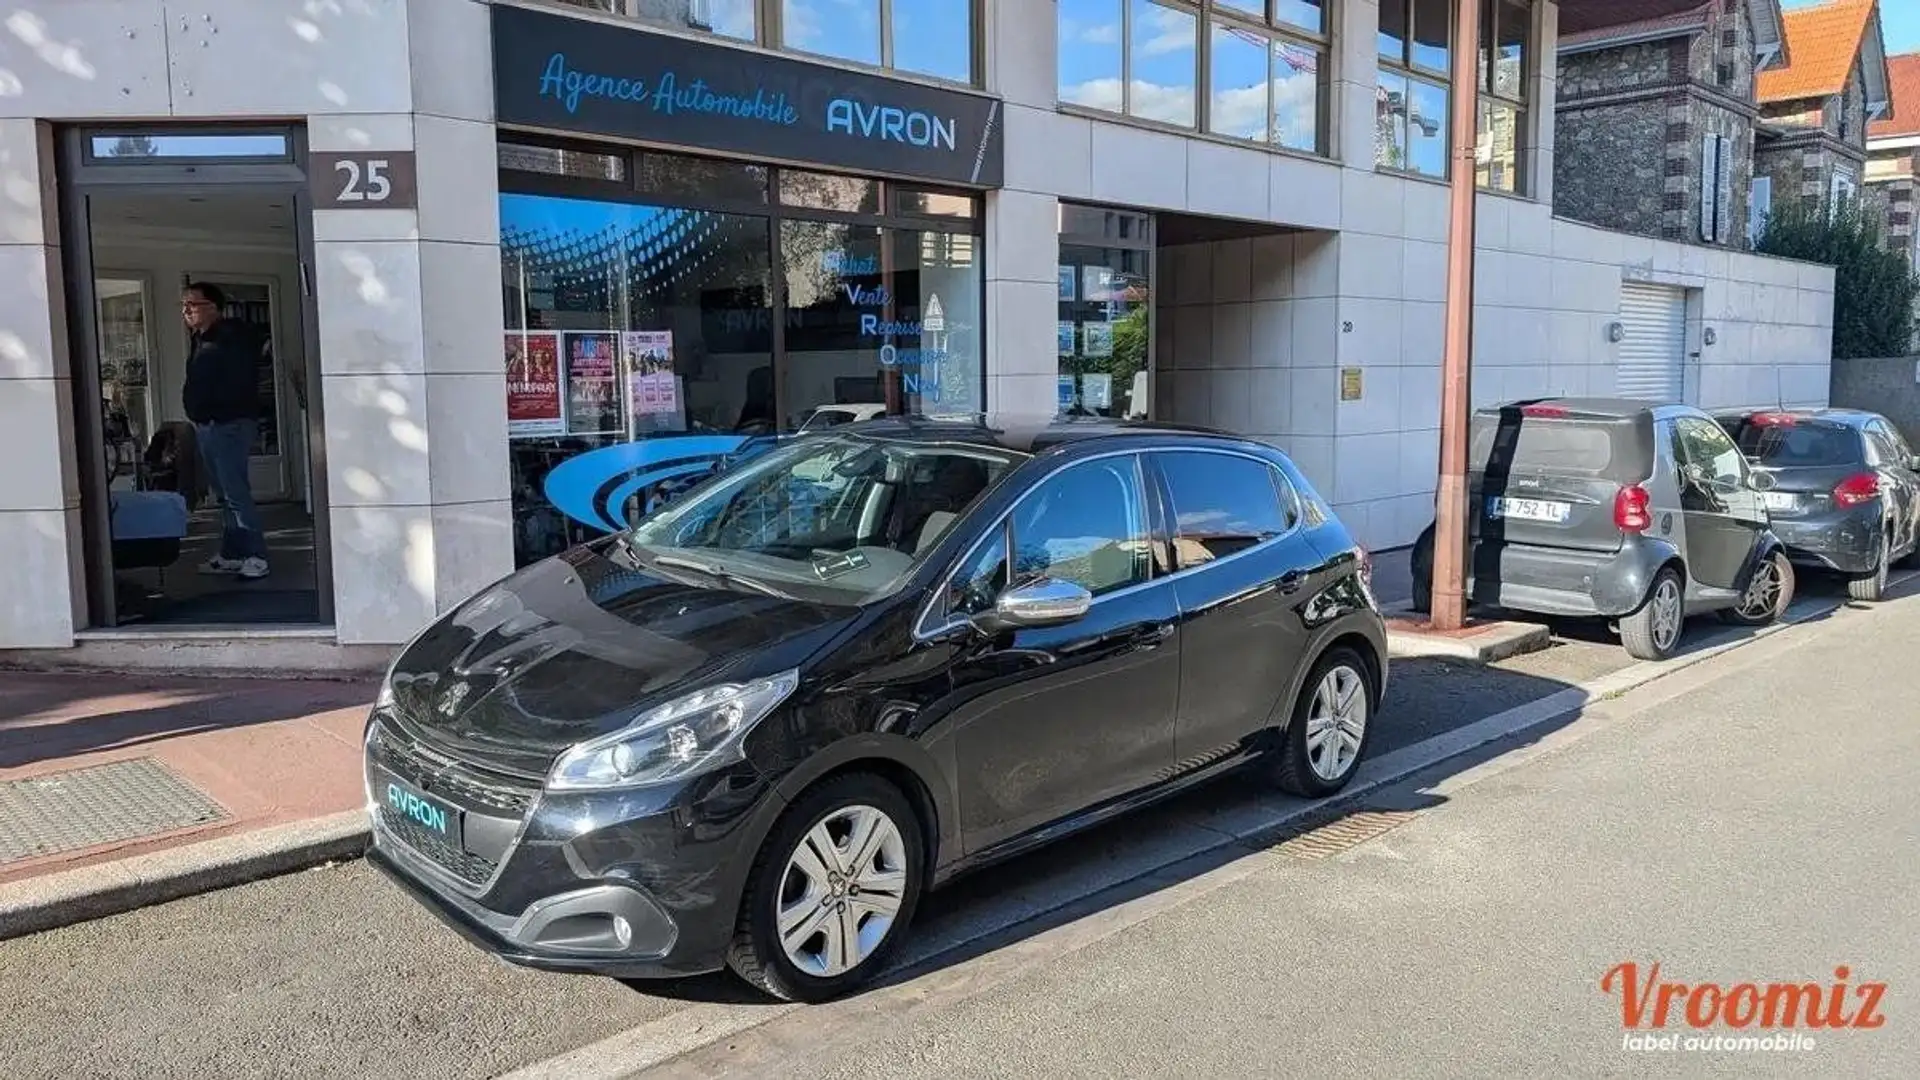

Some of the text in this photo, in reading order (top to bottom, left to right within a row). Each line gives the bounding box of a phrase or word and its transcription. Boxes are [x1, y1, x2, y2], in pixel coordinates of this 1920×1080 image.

[539, 52, 799, 125] Agence Automobile
[826, 98, 956, 152] AVRON
[334, 159, 392, 201] 25
[844, 283, 895, 306] Vente
[388, 784, 446, 834] AVRON
